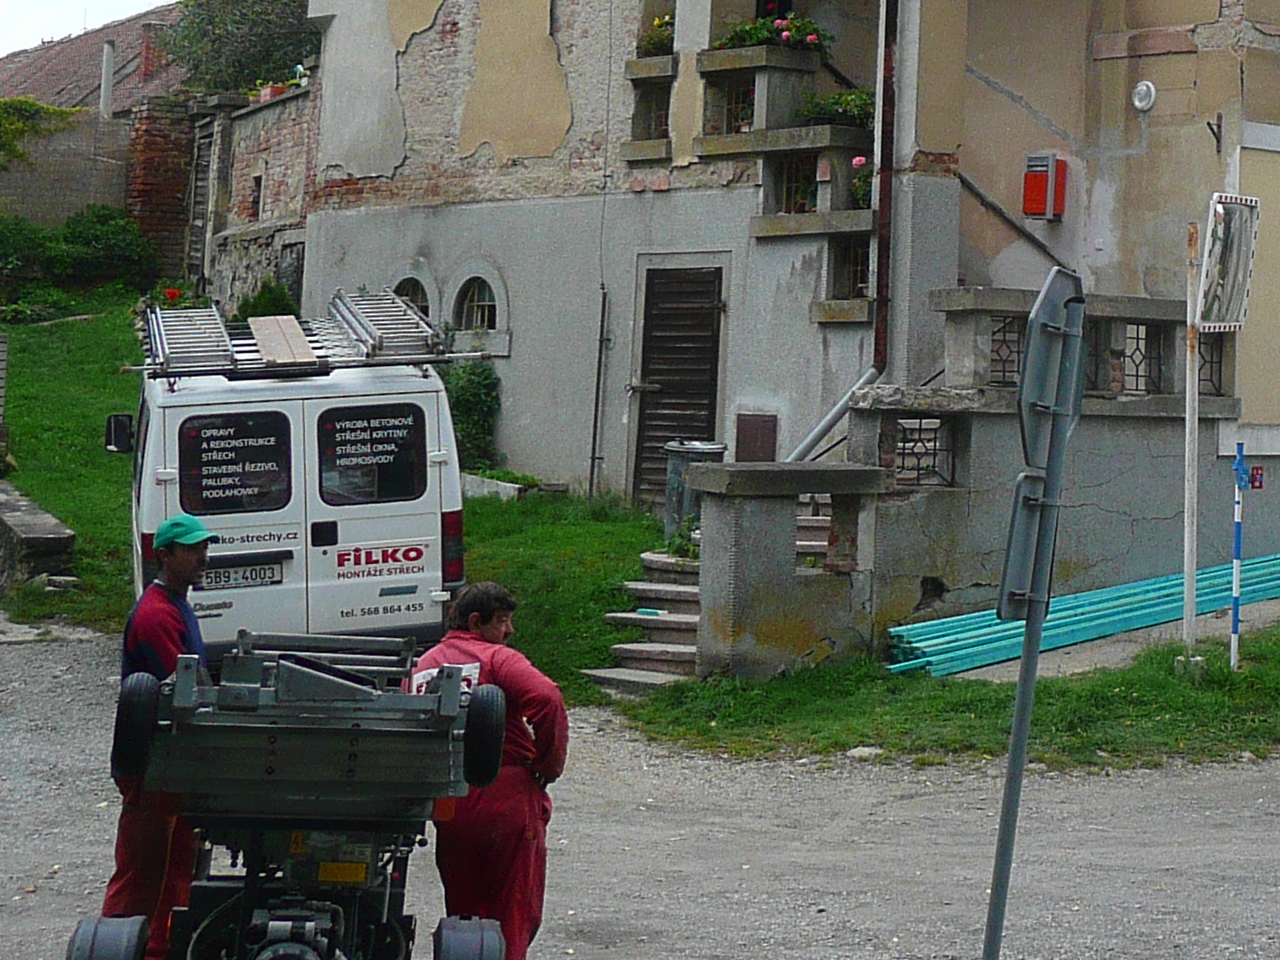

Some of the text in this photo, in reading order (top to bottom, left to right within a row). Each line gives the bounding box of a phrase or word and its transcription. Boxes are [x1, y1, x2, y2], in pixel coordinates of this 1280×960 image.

[335, 414, 414, 429] VÝROBA BETONOVÉ
[201, 428, 235, 438] OPRAVY
[335, 429, 408, 442] STŘEŠNÍ KRYTINY
[210, 437, 276, 448] REKONSTRUKCE
[336, 443, 371, 454] STŘEŠNÍ
[201, 450, 235, 461] STŘECH
[336, 455, 395, 466] HROMOSVODY
[201, 462, 279, 475] STAVEBNÍ ŘEZIVO,
[202, 476, 241, 487] PALUBKY,
[202, 487, 259, 499] PODLAHOVKY
[219, 532, 299, 544] ko-strechy.cz
[205, 570, 231, 585] 5B9
[241, 567, 275, 581] 4003
[337, 565, 424, 580] MONTÁŽE STŘECH
[340, 603, 424, 618] tel. 568 864 455
